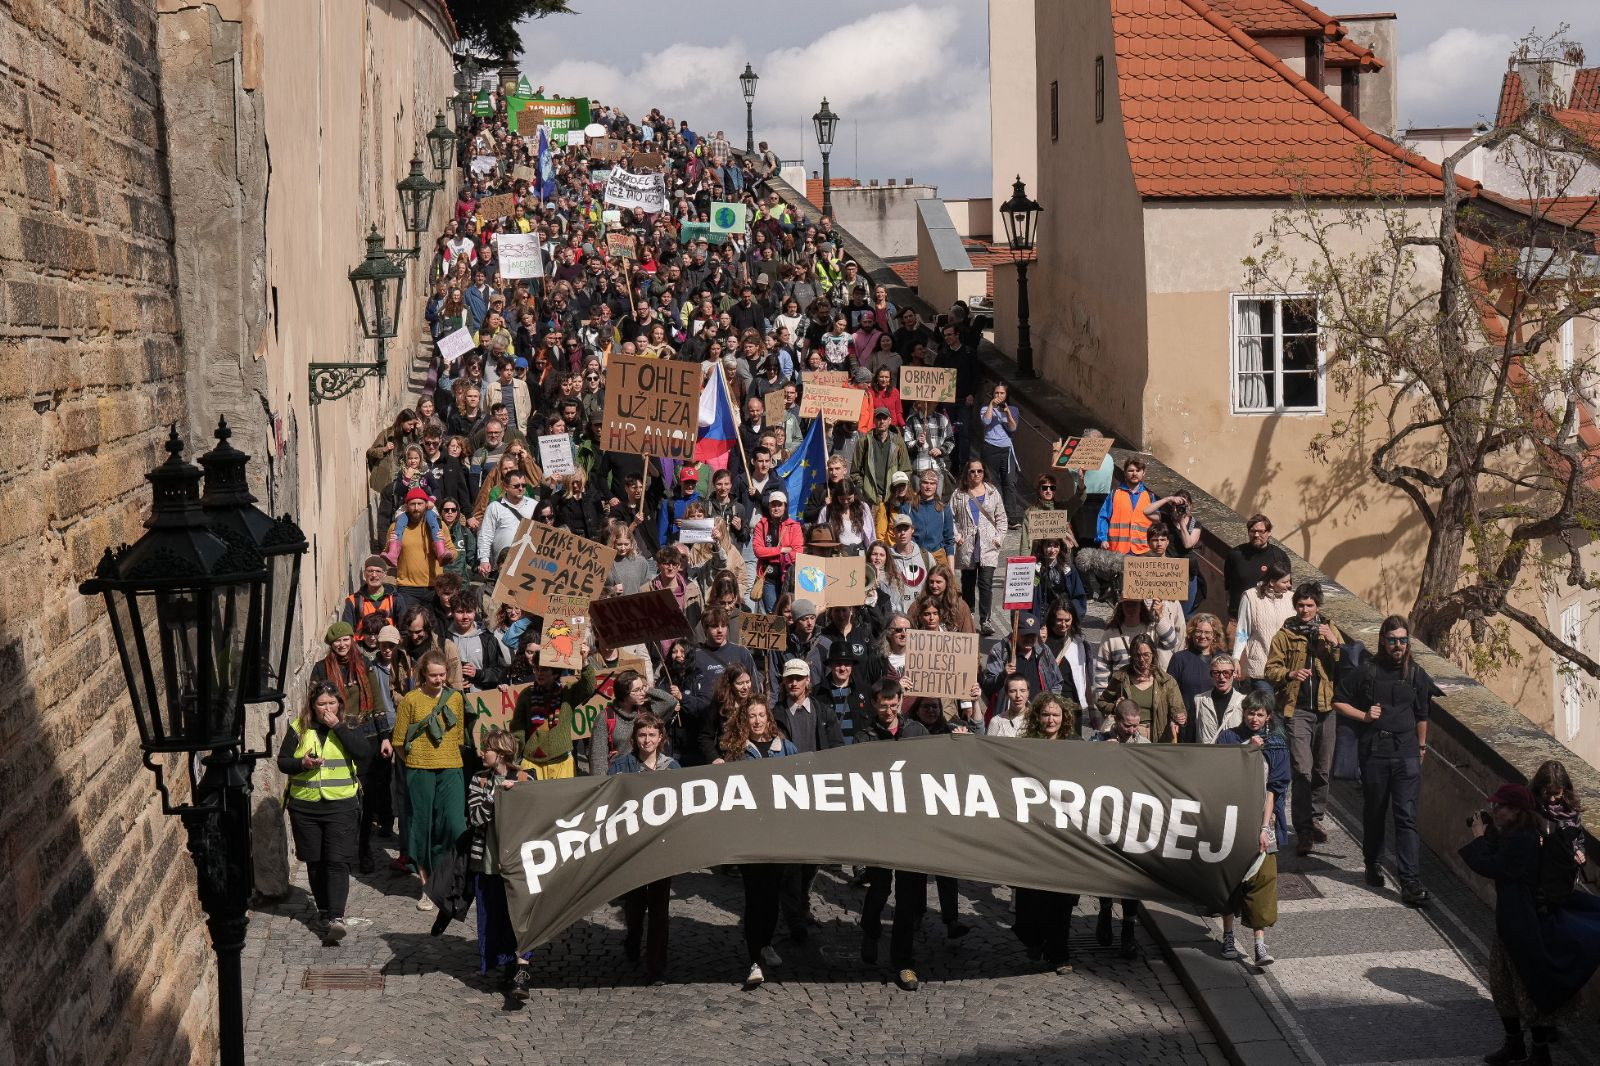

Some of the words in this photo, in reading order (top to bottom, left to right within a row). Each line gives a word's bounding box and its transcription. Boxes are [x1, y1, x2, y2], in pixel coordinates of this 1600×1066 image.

[612, 361, 695, 397] TOHLE
[904, 369, 945, 385] OBRANA
[915, 385, 937, 399] MZP
[617, 391, 647, 420] UŽ
[609, 421, 695, 458] HRANOU
[1128, 561, 1180, 570] MINISTERSTVO
[551, 569, 594, 594] ALE
[549, 595, 564, 604] THE
[755, 614, 769, 622] ZA
[747, 631, 781, 650] ZMIZ
[909, 632, 973, 655] MOTORISTI
[908, 652, 924, 670] DO
[928, 653, 956, 672] LESA
[520, 774, 757, 894] PŘÍRODA
[771, 760, 908, 814] NENÍ
[920, 773, 1000, 819] NA
[1011, 776, 1238, 863] PRODEJ
